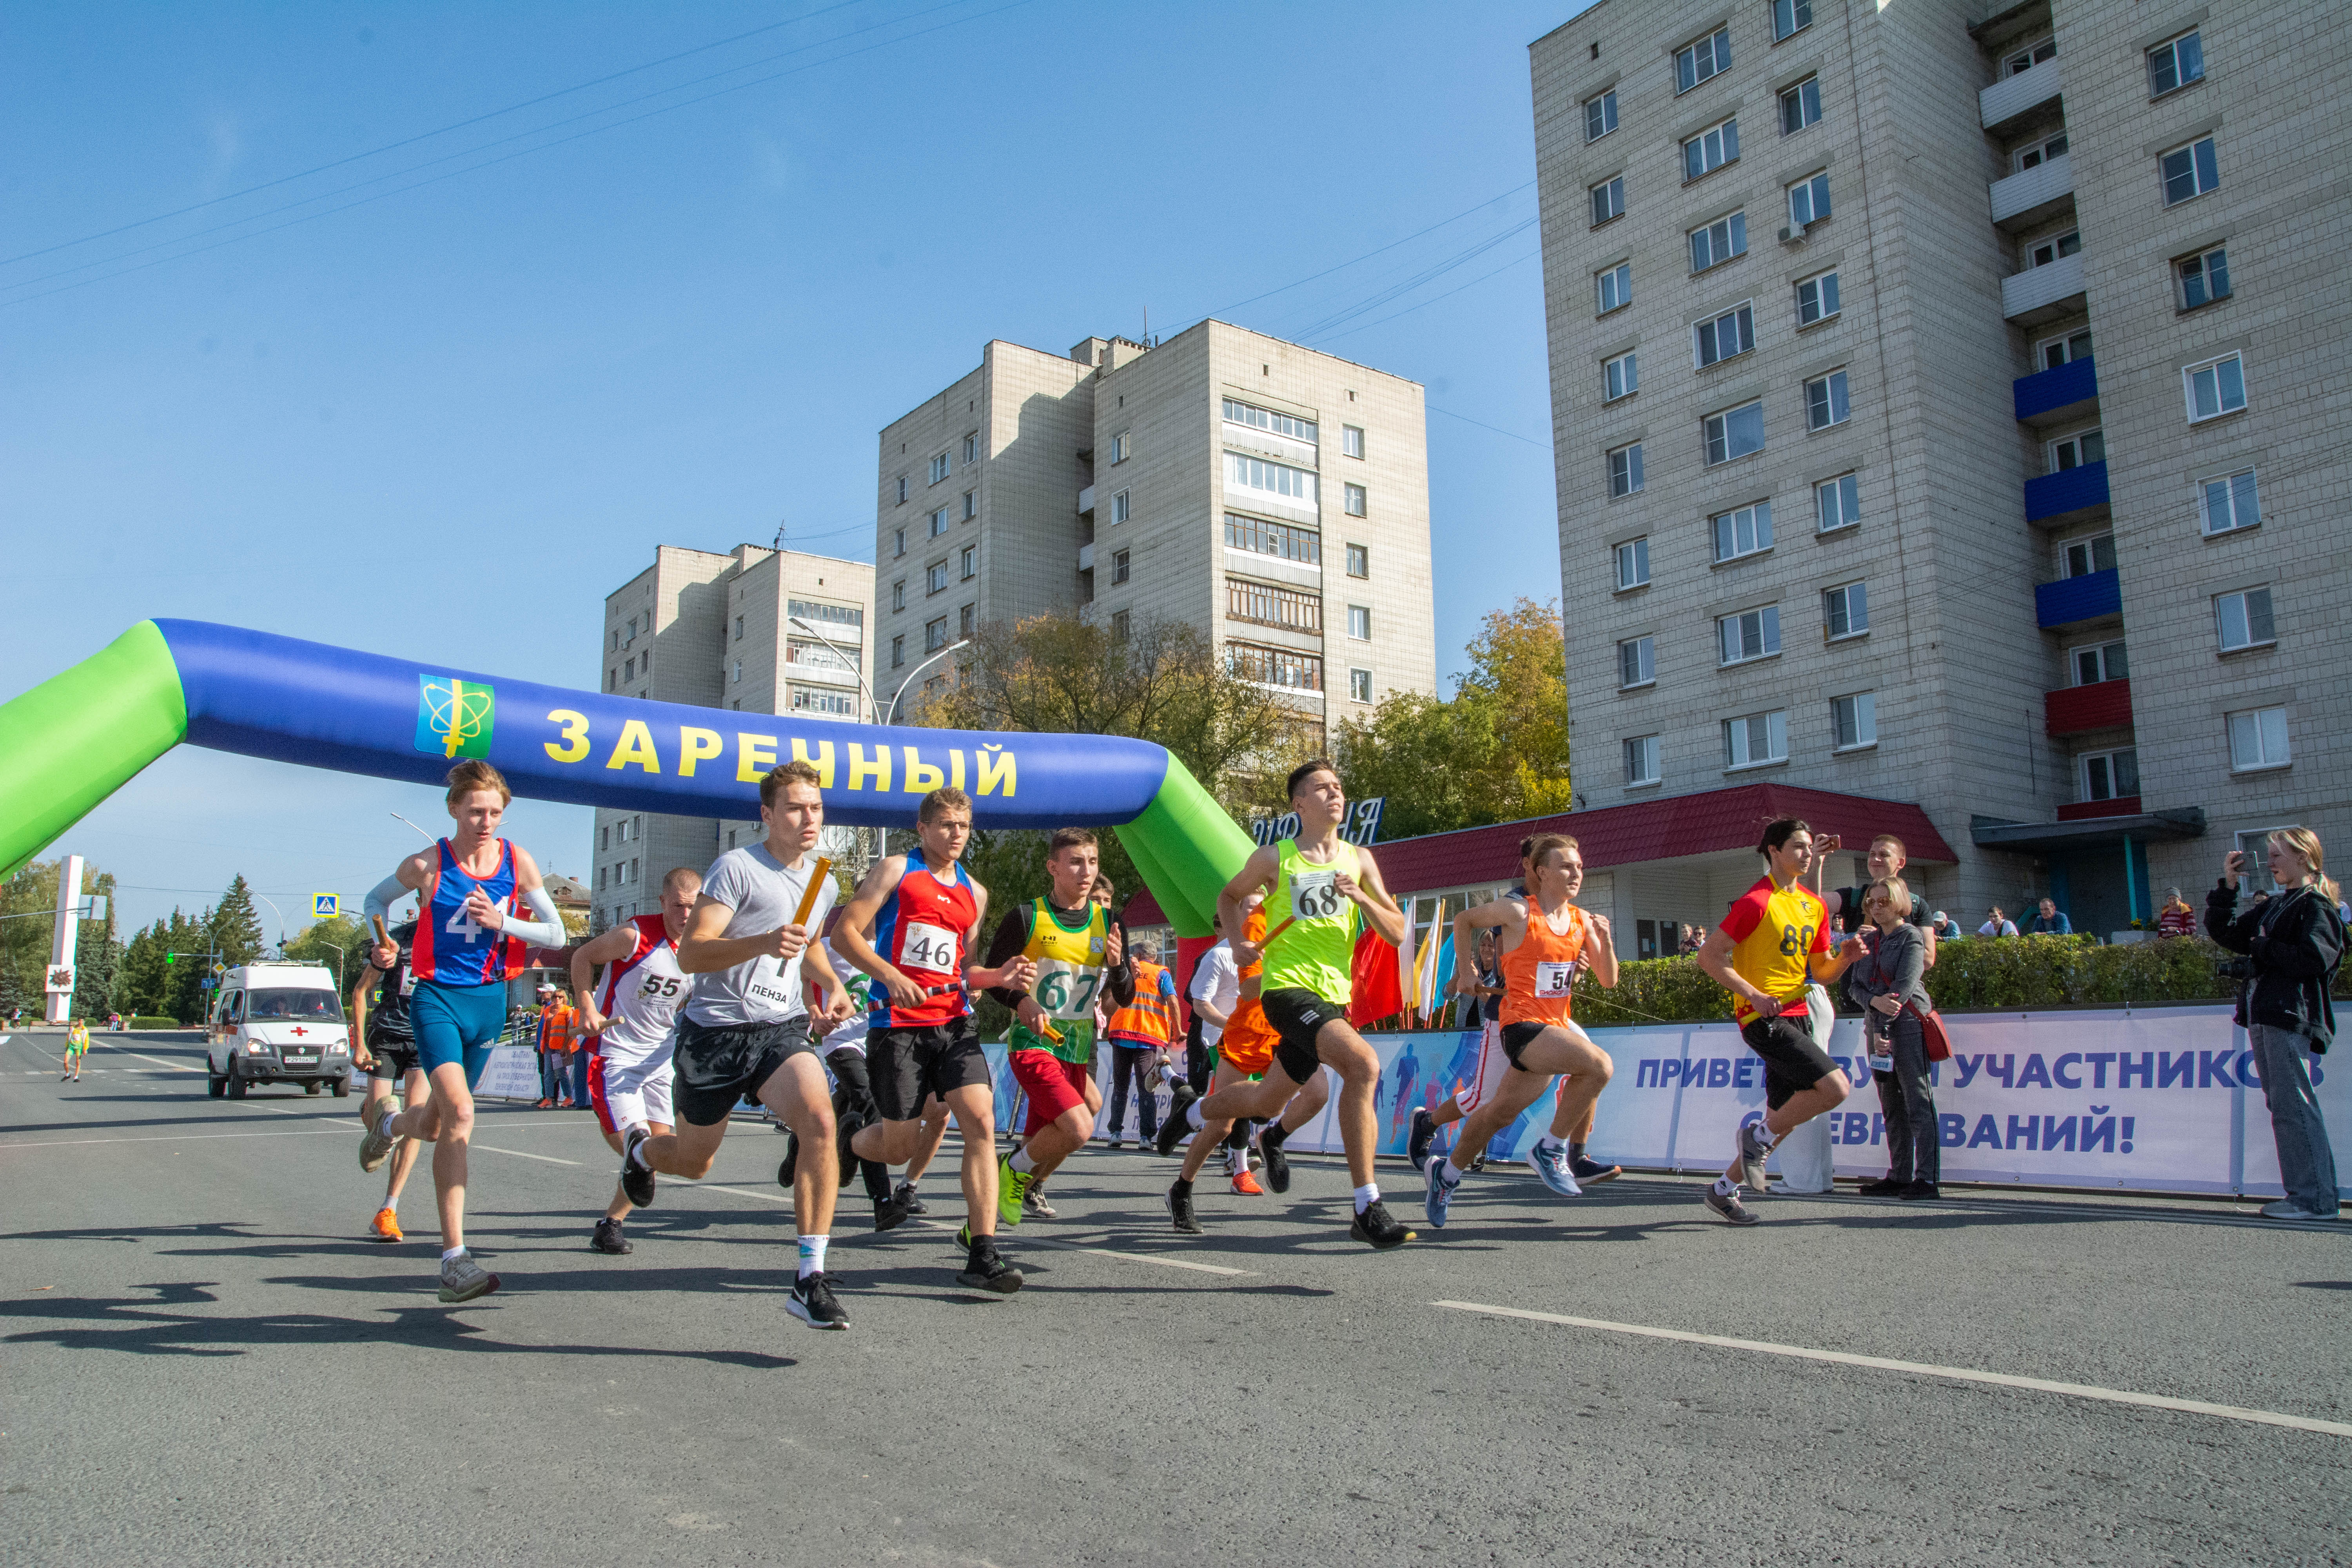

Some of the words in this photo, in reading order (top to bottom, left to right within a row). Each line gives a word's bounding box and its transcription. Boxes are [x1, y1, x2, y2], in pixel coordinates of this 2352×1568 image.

[544, 709, 1017, 797] ЗАРЕЧНЫЙ
[1299, 885, 1338, 916] 68
[911, 937, 951, 966] 46
[1780, 924, 1815, 956] 80
[643, 974, 682, 997] 55
[751, 984, 787, 1004] ПЕНЗА
[1036, 971, 1098, 1013] 67
[1552, 970, 1572, 990] 54
[1636, 1054, 1940, 1089] ПРИВЕВУ
[1739, 1105, 2135, 1154] СЕВНВАНИЙ!
